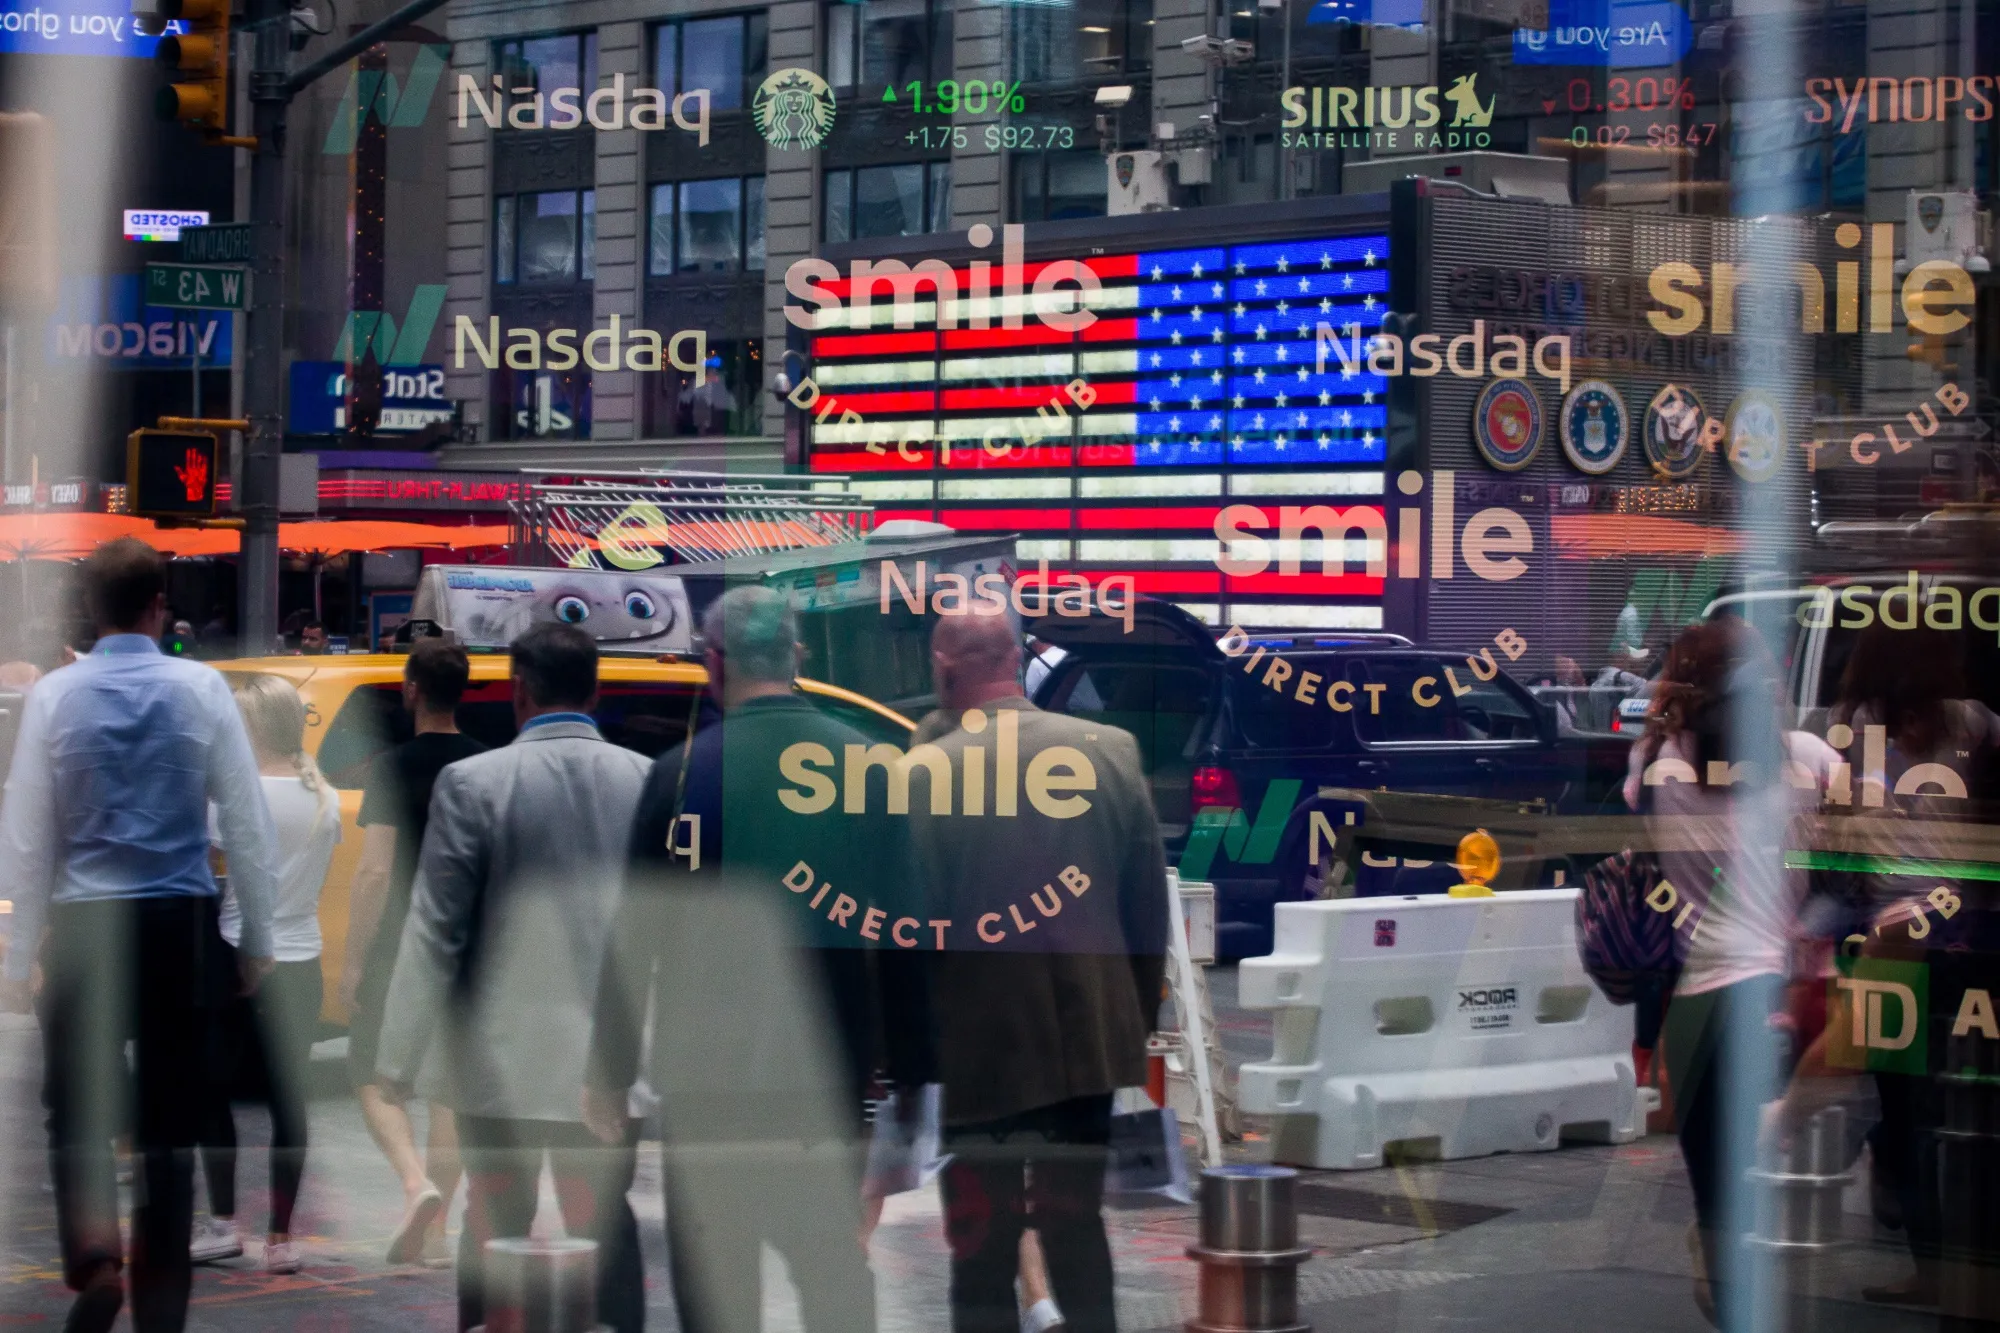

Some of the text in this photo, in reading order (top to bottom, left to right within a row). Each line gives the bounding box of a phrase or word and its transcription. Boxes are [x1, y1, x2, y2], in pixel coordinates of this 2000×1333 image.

[457, 72, 710, 147] Nasdaq
[905, 80, 1025, 115] 1.90%
[1280, 86, 1440, 129] SIRIUS
[1566, 77, 1695, 113] 0.30%
[905, 125, 1075, 151] +1.75 $92.73
[1280, 131, 1492, 149] SATELLITE RADIO
[1564, 123, 1718, 149] -0.02 $6.47
[783, 222, 1104, 332] smile
[1646, 222, 1976, 336] smile
[454, 314, 707, 388] Nasdaq
[1316, 320, 1571, 395] Nasdaq
[786, 376, 951, 465] DIRECT
[982, 378, 1098, 457] CLUB
[1849, 381, 1970, 465] CLUB
[1212, 470, 1534, 580] smile
[880, 559, 1136, 633] Nasdaq
[1219, 624, 1528, 714] DIRECT CLUB
[777, 709, 1098, 819] smile
[782, 859, 1092, 950] DIRECT CLUB
[1836, 978, 1918, 1050] TD
